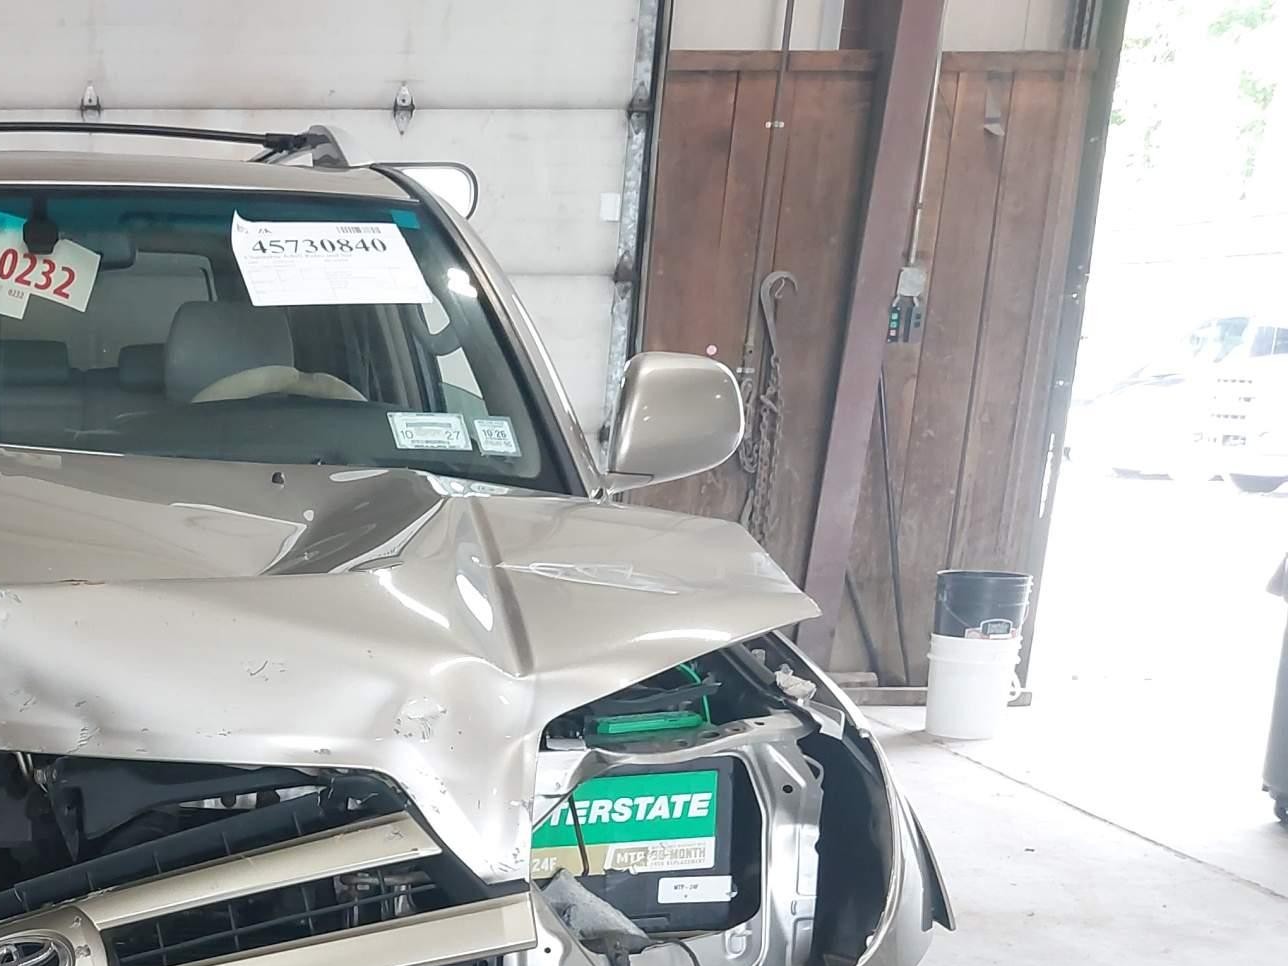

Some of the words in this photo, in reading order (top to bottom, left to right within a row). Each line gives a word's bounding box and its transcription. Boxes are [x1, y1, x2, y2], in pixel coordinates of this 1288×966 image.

[252, 238, 387, 254] 45730840
[400, 430, 414, 440] 10
[445, 430, 460, 441] 27
[550, 792, 712, 827] TERSTATE
[532, 856, 557, 873] 24F
